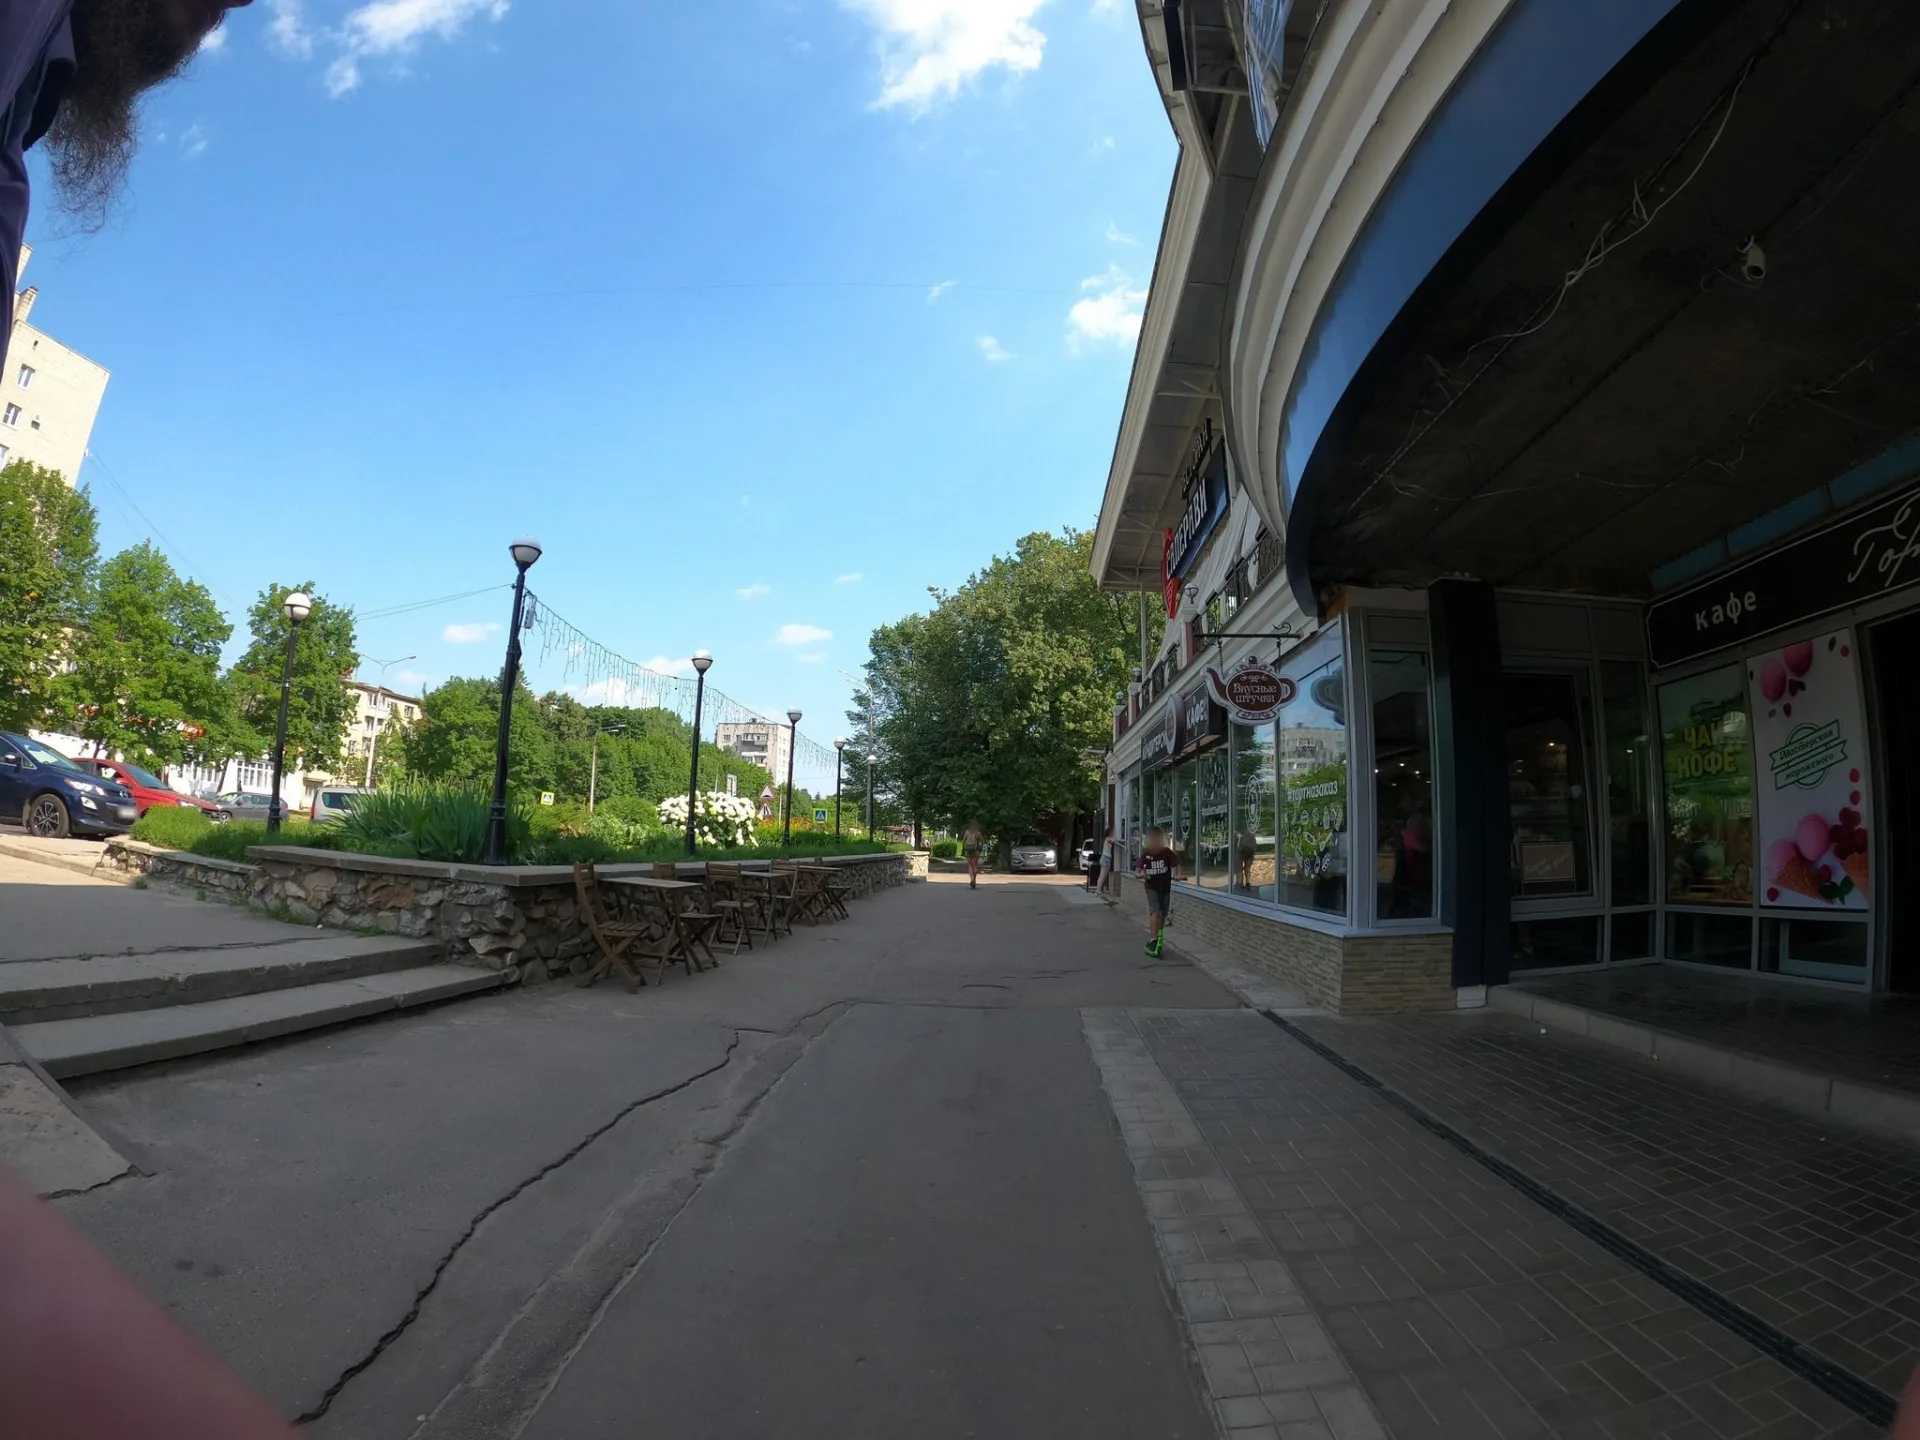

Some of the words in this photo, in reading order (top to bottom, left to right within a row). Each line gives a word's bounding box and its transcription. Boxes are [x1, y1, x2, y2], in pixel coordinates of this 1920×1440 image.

[1695, 591, 1757, 631] кафе
[1233, 683, 1277, 696] Вкусные
[1780, 729, 1834, 760] Мастерская
[1677, 745, 1737, 780] КОФЕ
[1785, 753, 1834, 781] мороженого
[1151, 860, 1164, 869] BIG
